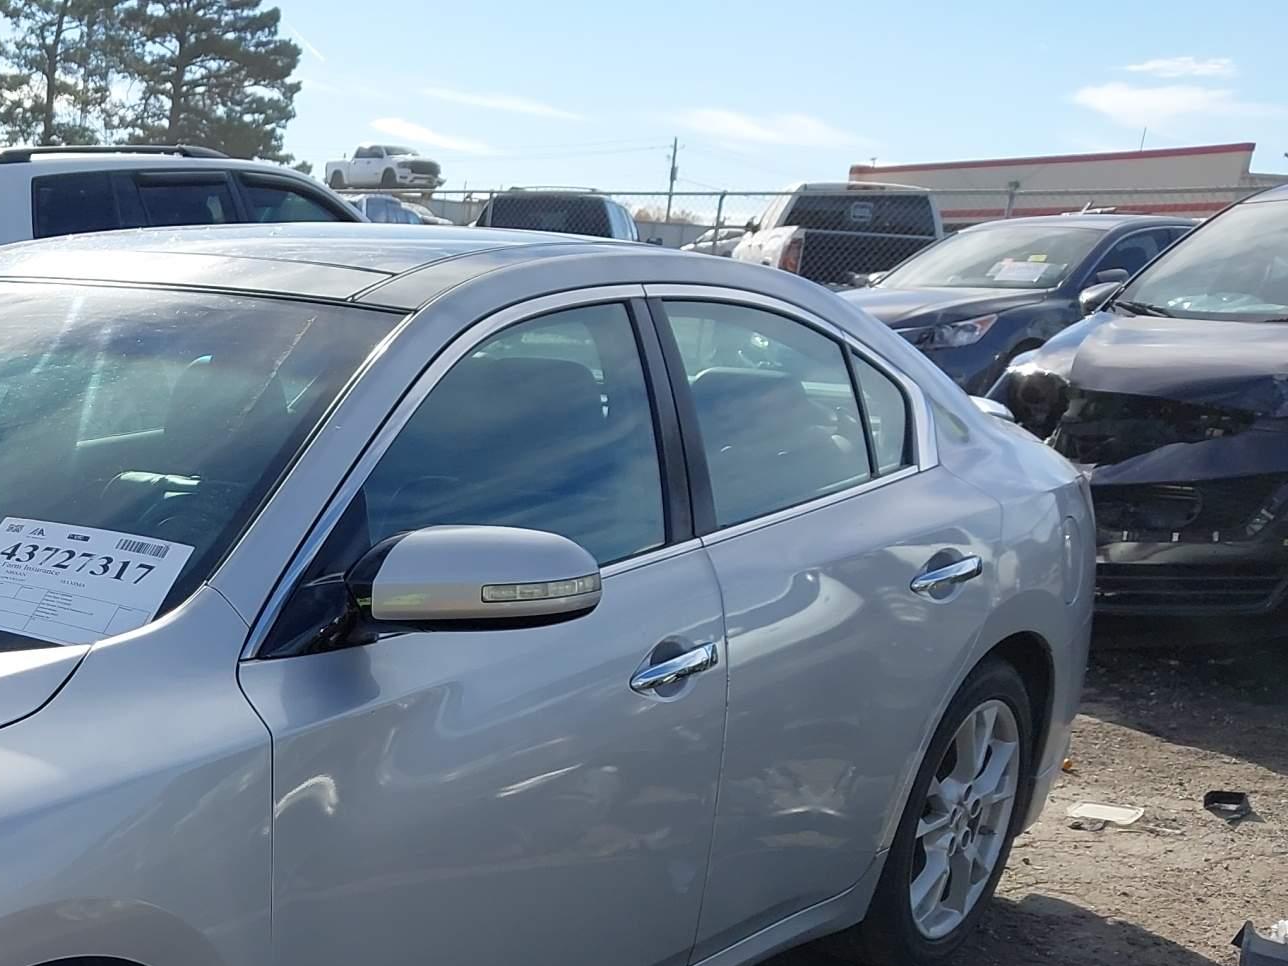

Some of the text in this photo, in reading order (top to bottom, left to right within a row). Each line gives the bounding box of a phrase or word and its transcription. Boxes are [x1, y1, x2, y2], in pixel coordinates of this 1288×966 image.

[0, 541, 155, 585] 43727317
[1, 561, 23, 570] Farm
[23, 564, 61, 577] Insurance
